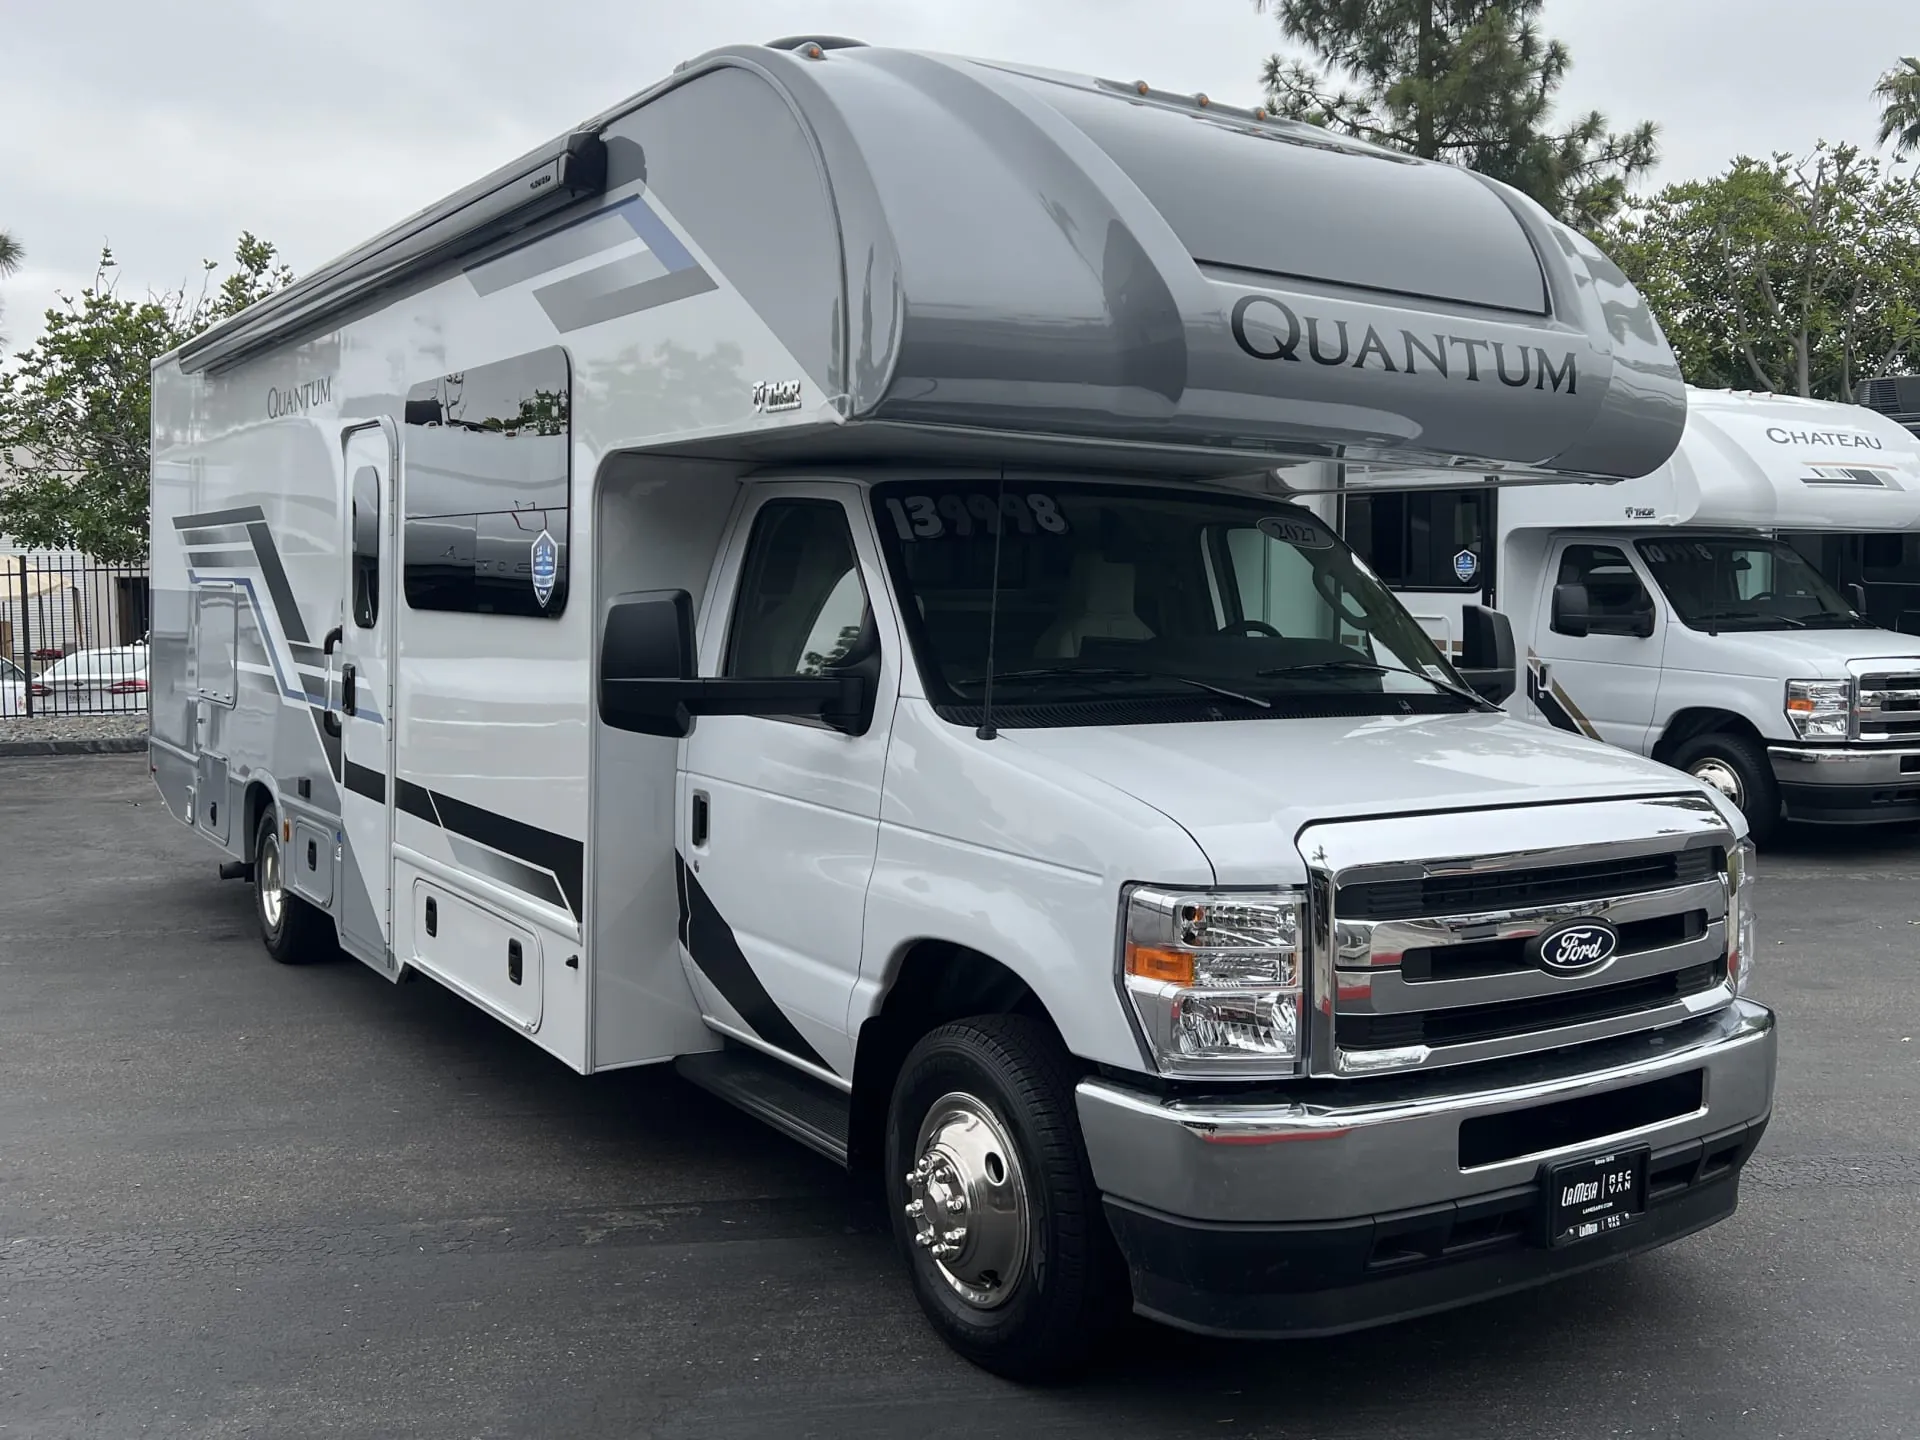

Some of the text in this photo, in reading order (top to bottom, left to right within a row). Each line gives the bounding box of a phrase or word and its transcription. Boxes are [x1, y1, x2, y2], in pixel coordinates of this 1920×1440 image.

[1230, 294, 1577, 395] QUANTUM
[267, 375, 332, 420] QUANTUM
[1766, 427, 1882, 450] CHATEAU
[885, 493, 1069, 542] 139998
[1556, 931, 1603, 963] Ford
[1608, 1170, 1632, 1185] REC
[1608, 1180, 1631, 1194] VAN
